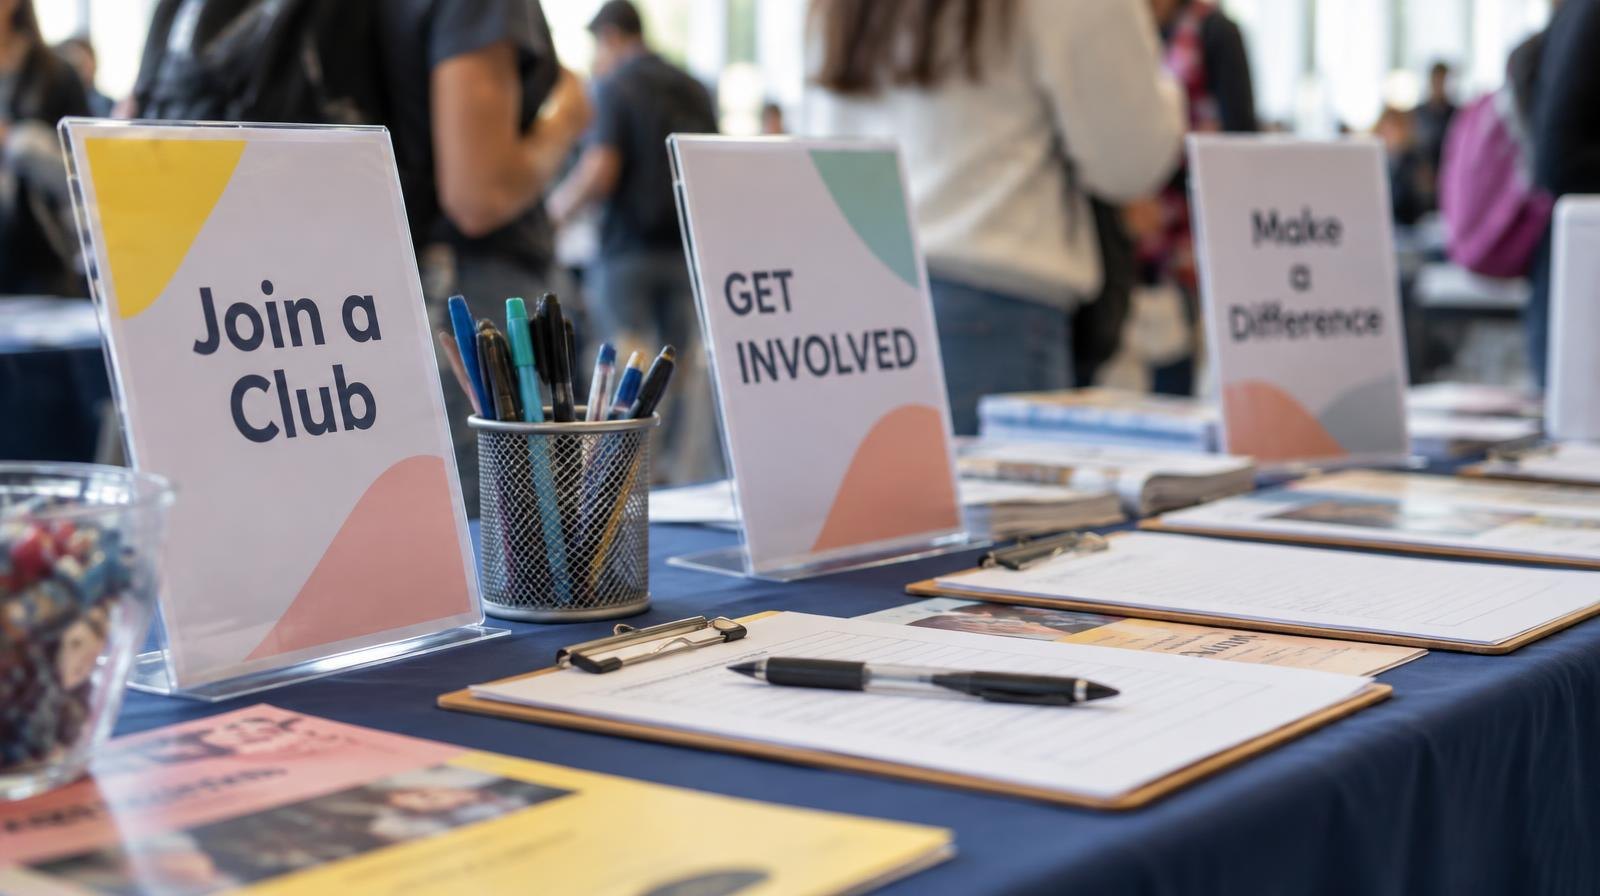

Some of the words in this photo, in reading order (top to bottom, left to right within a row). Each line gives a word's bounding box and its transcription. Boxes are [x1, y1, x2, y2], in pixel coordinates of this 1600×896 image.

[1252, 206, 1342, 246] Make
[724, 270, 793, 316] GET
[1289, 264, 1312, 291] a
[193, 279, 326, 356] Join
[342, 294, 382, 343] a
[1230, 302, 1383, 340] Difference
[737, 328, 917, 384] INVOLVED
[230, 364, 377, 443] Club
